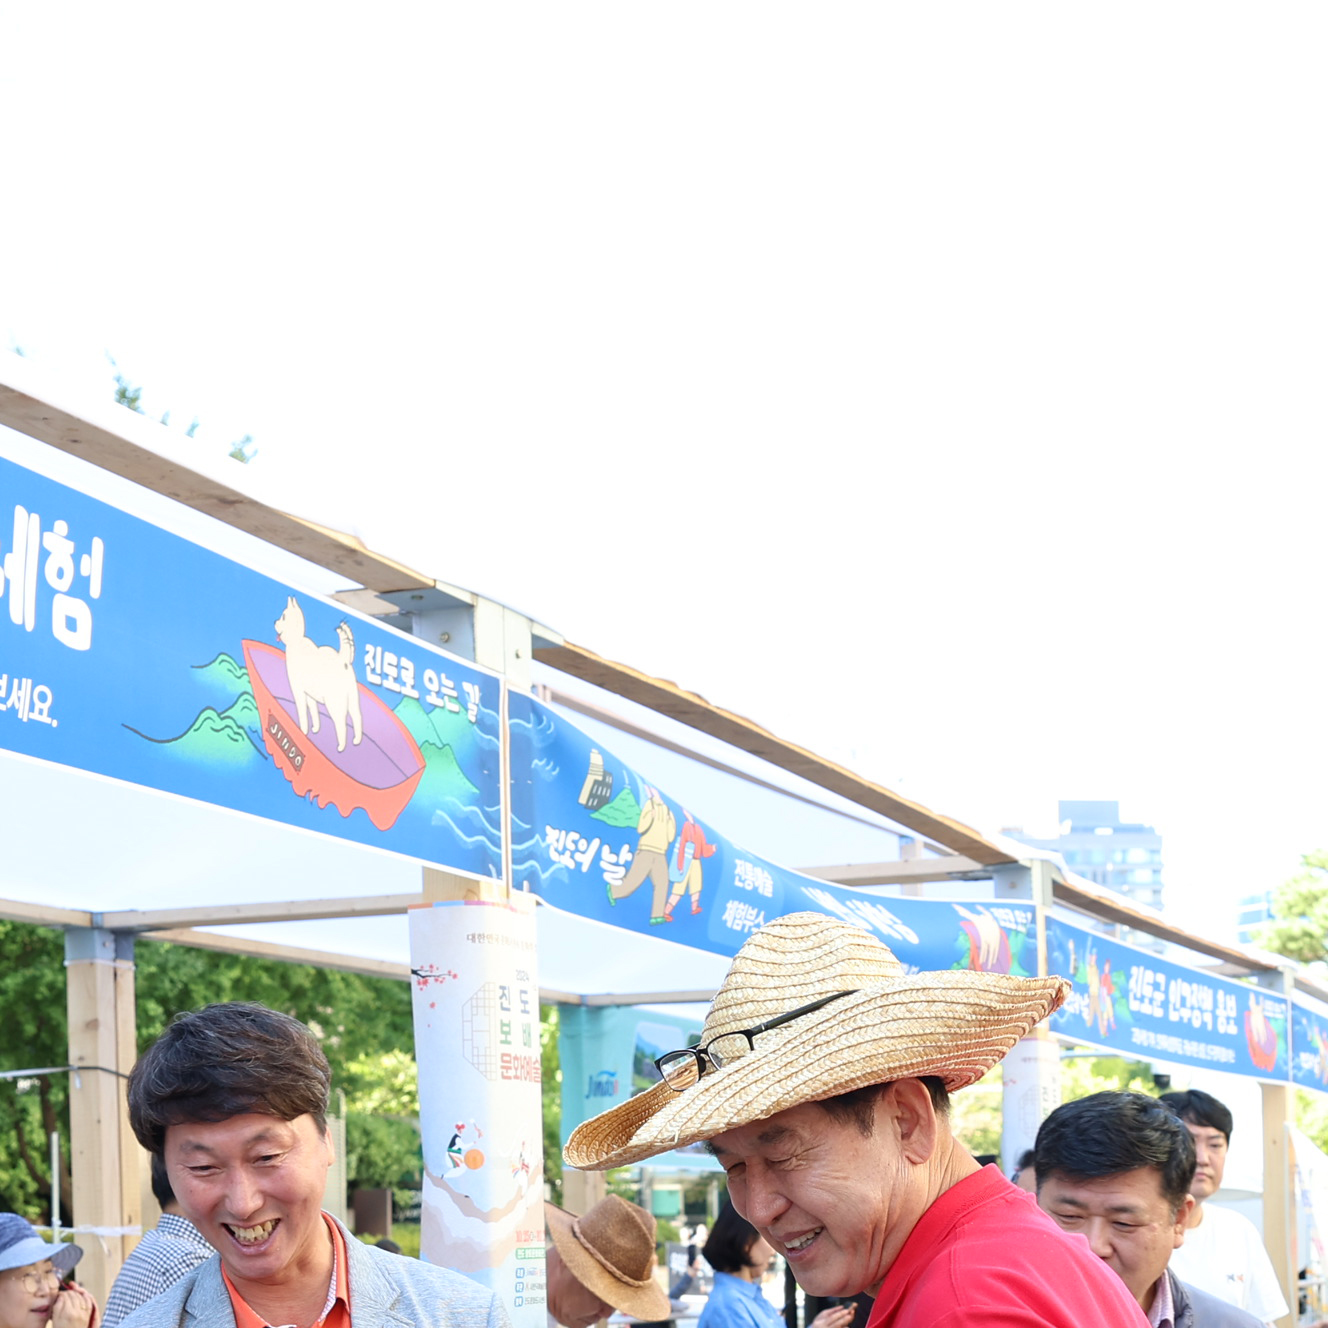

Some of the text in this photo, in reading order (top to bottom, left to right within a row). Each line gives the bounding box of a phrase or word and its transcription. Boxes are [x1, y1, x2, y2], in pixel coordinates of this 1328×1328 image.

[364, 643, 481, 724] 진도로 오는 길
[270, 723, 303, 767] JINDO
[545, 824, 633, 887] 진도의 날
[734, 858, 774, 899] 전통예술
[1128, 965, 1167, 1019] 진도군
